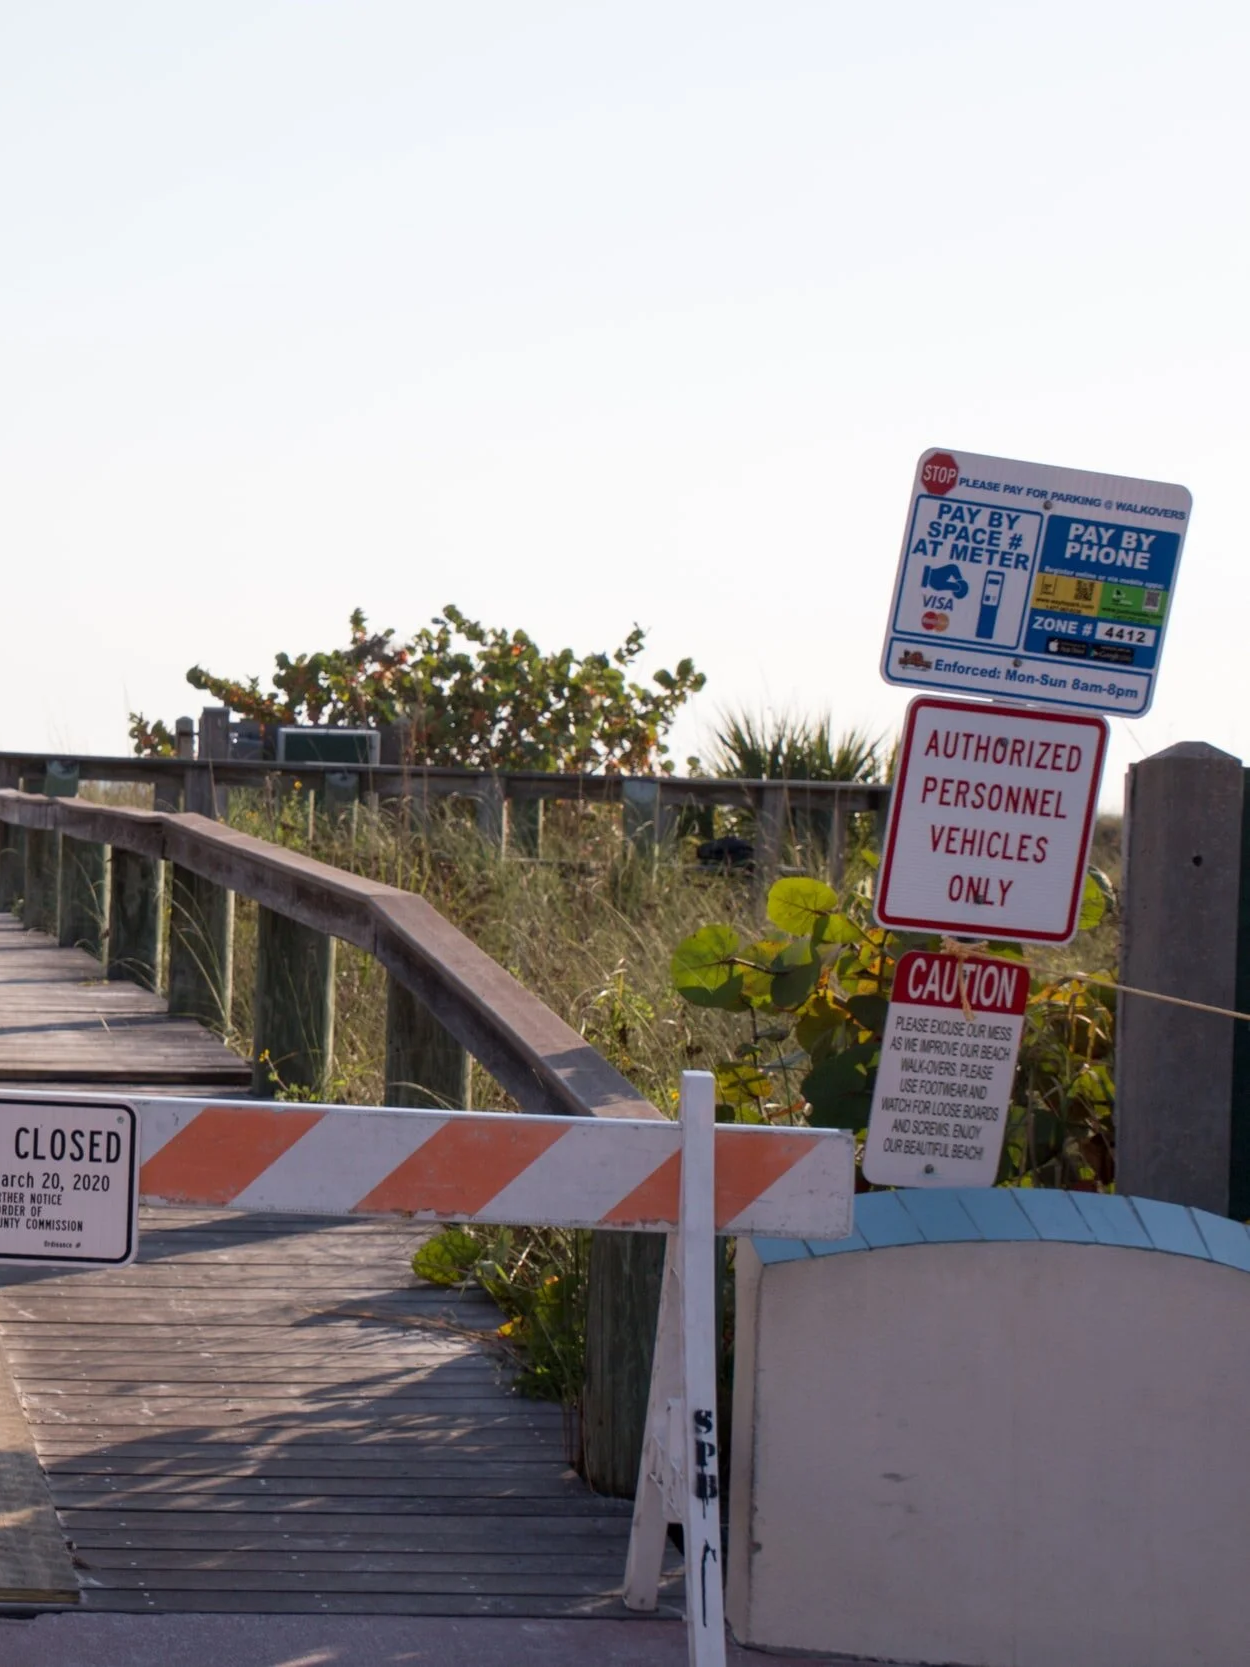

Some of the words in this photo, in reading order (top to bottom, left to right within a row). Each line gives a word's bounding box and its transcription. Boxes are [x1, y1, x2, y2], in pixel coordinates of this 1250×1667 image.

[922, 463, 956, 484] STOP
[959, 477, 1000, 492] PLEASE
[1003, 484, 1024, 495] PAY
[1026, 487, 1048, 499] FOR
[1051, 491, 1101, 508] PARKING
[1115, 502, 1186, 520] WALKOVERS
[937, 503, 982, 525] PAY
[987, 511, 1021, 530] BY
[927, 522, 1003, 548] SPACE
[1008, 533, 1023, 550] #
[1068, 523, 1115, 544] PAY
[1121, 531, 1156, 551] BY
[911, 539, 944, 558] AT
[949, 544, 1030, 571] METER
[1064, 541, 1150, 570] PHONE
[921, 594, 954, 611] VISA
[1032, 616, 1078, 634] ZONE
[1082, 624, 1093, 636] #
[1105, 626, 1146, 643] 4412
[934, 659, 1002, 681] Enforced:
[1005, 669, 1067, 690] Mon-Sun
[1072, 678, 1139, 699] 8am-8pm
[924, 730, 1082, 773] AUTHORIZED
[921, 776, 1067, 819] PERSONNEL
[931, 825, 1048, 863] VEHICLES
[948, 875, 1013, 907] ONLY
[896, 1016, 929, 1033] PLEASE
[930, 1019, 966, 1036] EXCUSE
[966, 1023, 986, 1038] OUR
[988, 1026, 1012, 1041] MESS
[890, 1036, 903, 1050] AS
[904, 1038, 918, 1052] WE
[919, 1039, 959, 1056] IMPROVE
[960, 1043, 980, 1058] OUR
[980, 1045, 1011, 1060] BEACH
[960, 1063, 994, 1080] PLEASE
[900, 1079, 918, 1093] USE
[919, 1080, 969, 1097] FOOTWEAR
[970, 1085, 987, 1099] AND
[881, 1097, 911, 1113] WATCH
[912, 1100, 931, 1116] FOR
[931, 1101, 963, 1118] LOOSE
[963, 1106, 998, 1122] BOARDS
[892, 1119, 910, 1133] AND
[952, 1124, 982, 1139] ENJOY
[15, 1127, 121, 1164] CLOSED
[883, 1138, 903, 1152] OUR
[903, 1140, 949, 1158] BEAUTIFUL
[42, 1172, 64, 1192] 20,
[73, 1174, 110, 1191] 2020
[31, 1193, 63, 1206] NOTICE
[31, 1206, 42, 1216] OF
[26, 1219, 83, 1232] COMMISSION
